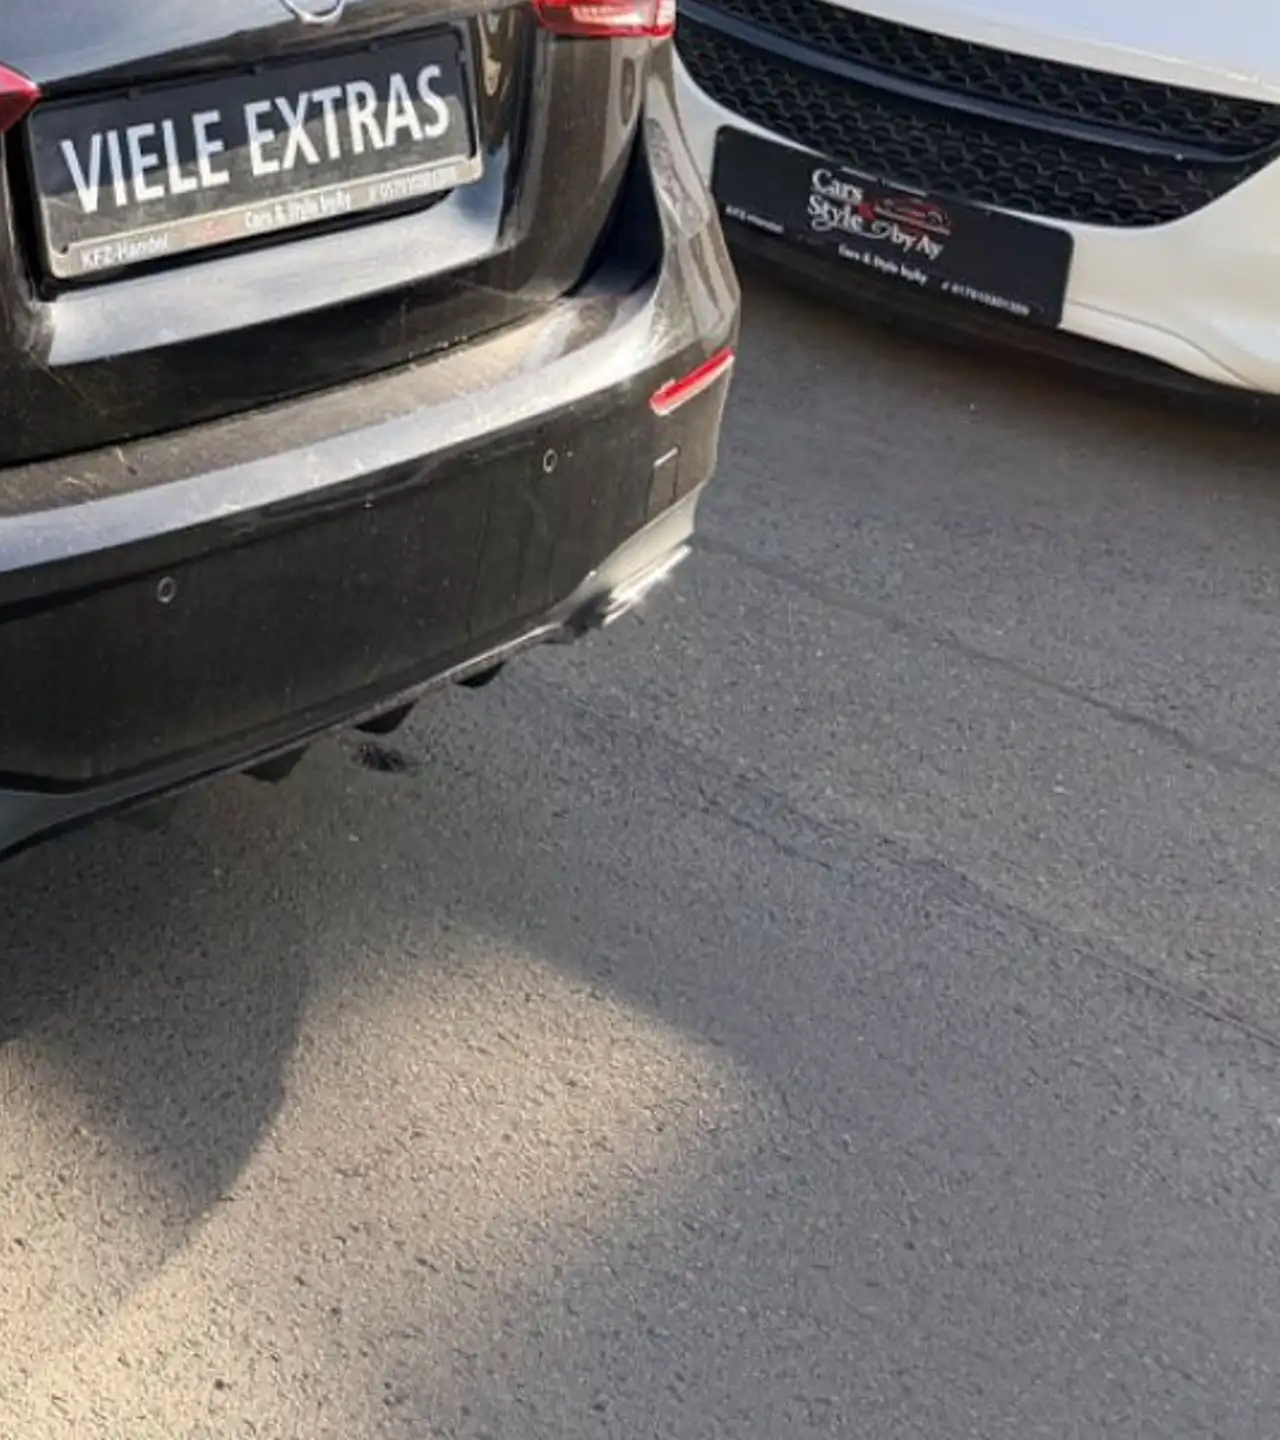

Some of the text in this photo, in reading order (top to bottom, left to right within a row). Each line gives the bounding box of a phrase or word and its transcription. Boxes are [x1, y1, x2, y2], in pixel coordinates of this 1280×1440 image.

[60, 64, 451, 214] VIELE EXTRAS
[811, 167, 865, 203] Cars
